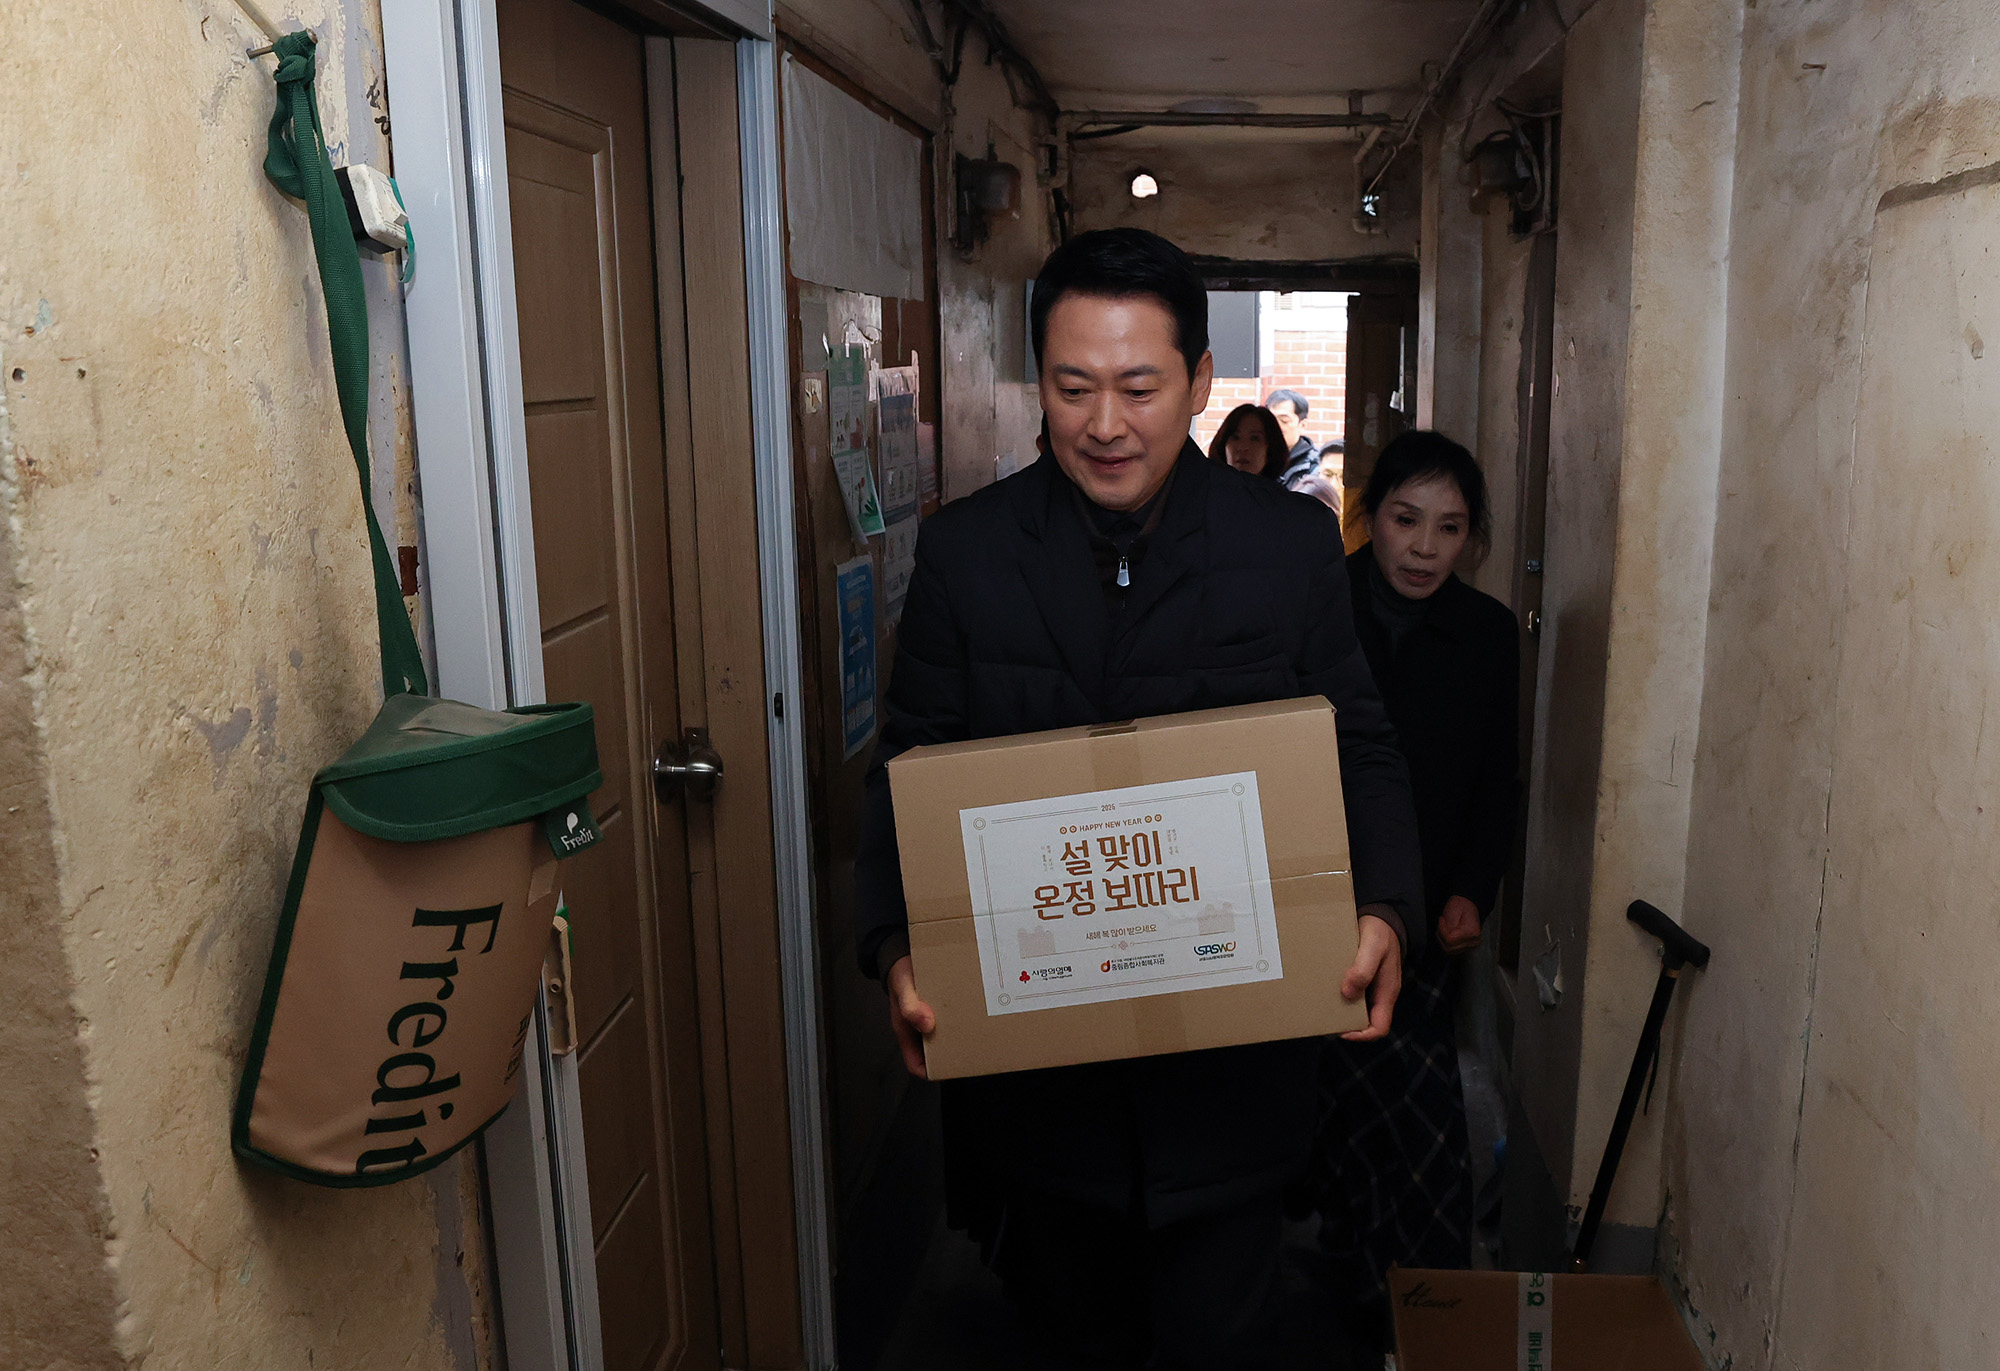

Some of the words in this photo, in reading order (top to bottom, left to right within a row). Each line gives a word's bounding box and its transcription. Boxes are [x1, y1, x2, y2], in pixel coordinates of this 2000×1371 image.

[1101, 803, 1116, 812] 2026
[1079, 823, 1103, 832] HAPPY
[1105, 820, 1121, 829] NEW
[1122, 817, 1142, 827] YEAR
[560, 827, 595, 851] Fredit
[1060, 839, 1093, 877] 설
[1096, 830, 1163, 873] 맞이
[1032, 880, 1096, 921] 온정
[1101, 866, 1200, 913] 보따리
[1086, 931, 1101, 941] 새해
[1102, 930, 1110, 938] 복
[1110, 928, 1126, 938] 많이
[1127, 924, 1157, 935] 받으세요
[355, 902, 504, 1175] Fredit
